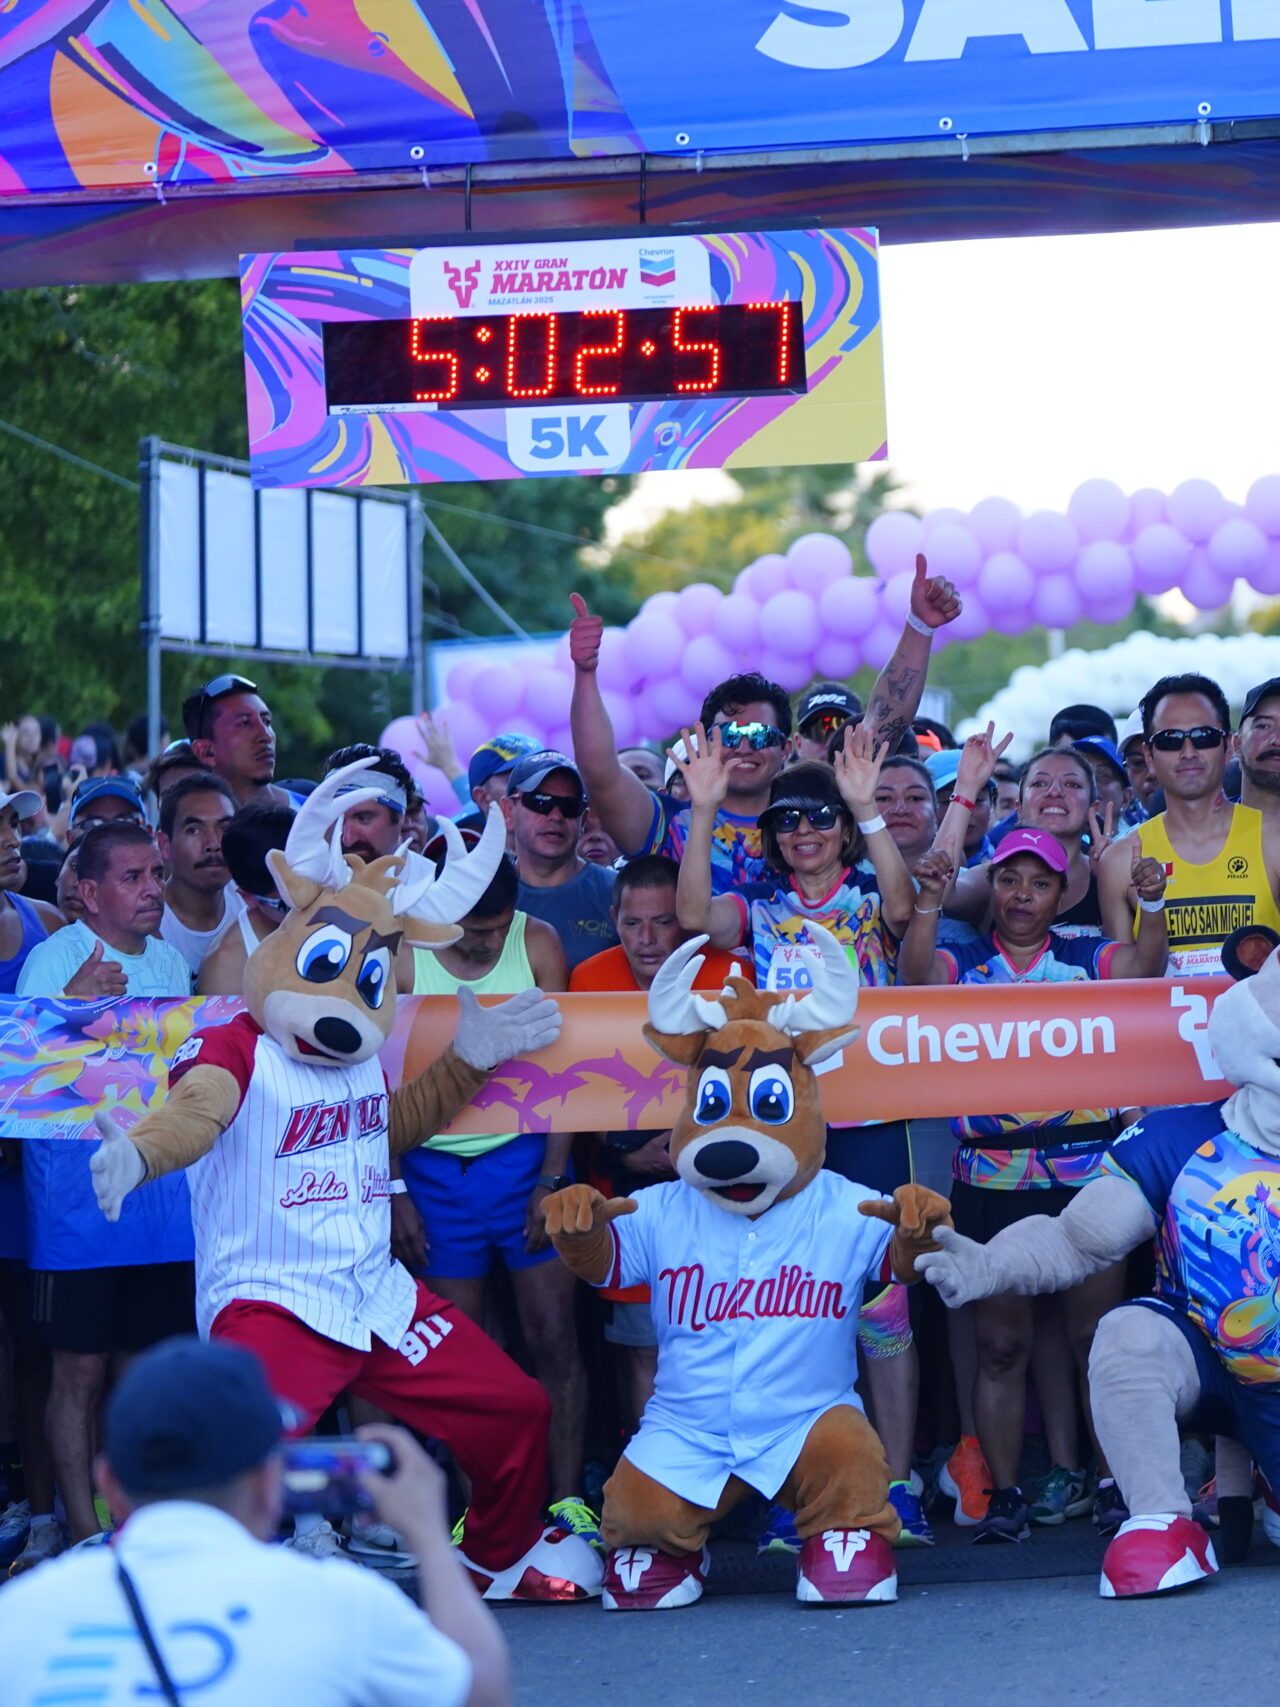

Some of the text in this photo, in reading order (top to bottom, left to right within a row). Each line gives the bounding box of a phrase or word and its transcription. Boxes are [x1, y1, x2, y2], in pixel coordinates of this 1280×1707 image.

[493, 257, 569, 272] XXIV GRAN
[638, 248, 675, 256] Chevron
[490, 266, 628, 294] MARATÓN
[488, 295, 554, 306] MAZATLÁN 2025
[529, 414, 610, 459] 5K
[1167, 906, 1198, 937] ETICO
[1199, 906, 1219, 935] SAN
[776, 967, 813, 989] 50
[867, 1014, 1116, 1067] Chevron
[280, 1171, 348, 1208] Salsa
[658, 1263, 847, 1332] Mazatlán
[398, 1313, 455, 1367] 911
